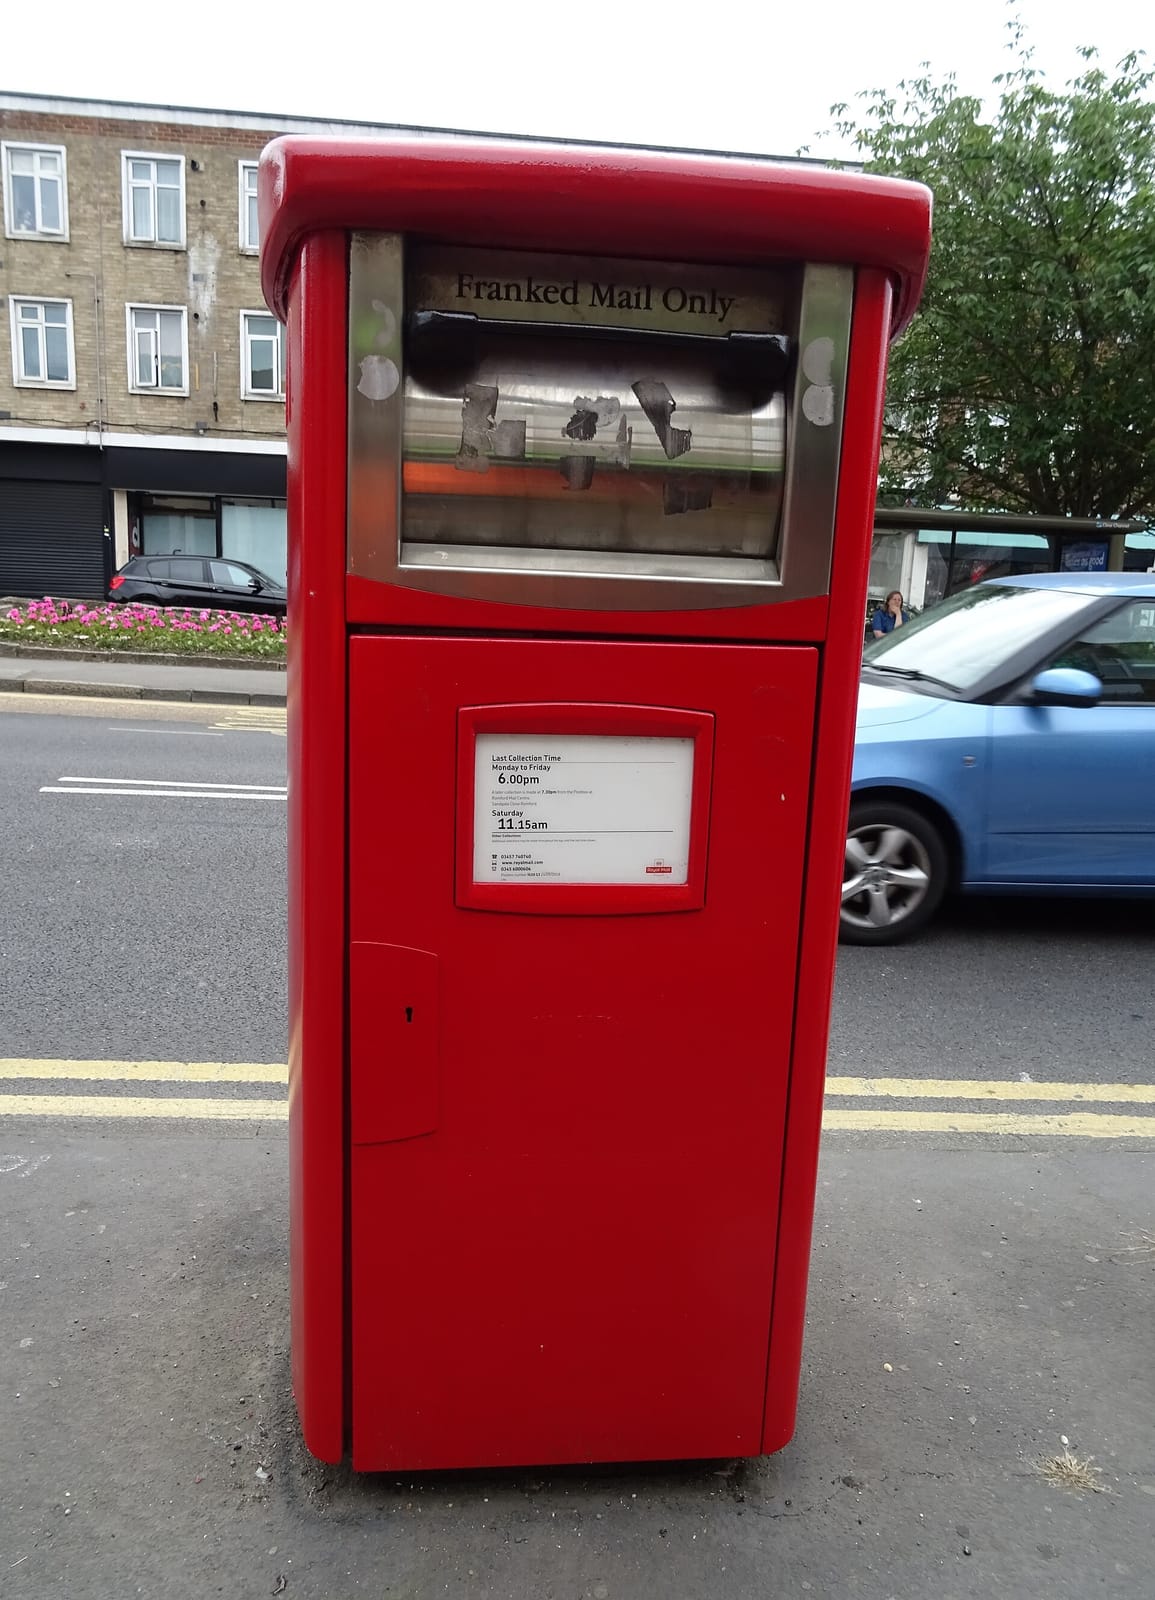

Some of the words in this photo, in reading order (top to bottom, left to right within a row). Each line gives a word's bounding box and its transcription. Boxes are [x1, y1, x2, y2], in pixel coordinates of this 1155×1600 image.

[457, 272, 579, 306] Franked
[588, 282, 653, 312] Mail
[662, 286, 736, 322] Only
[1088, 552, 1105, 571] good
[492, 764, 519, 772] Monday
[529, 764, 551, 772] Friday
[498, 773, 540, 786] 6.00pm
[492, 809, 524, 818] Saturday
[498, 818, 548, 830] 11.15am
